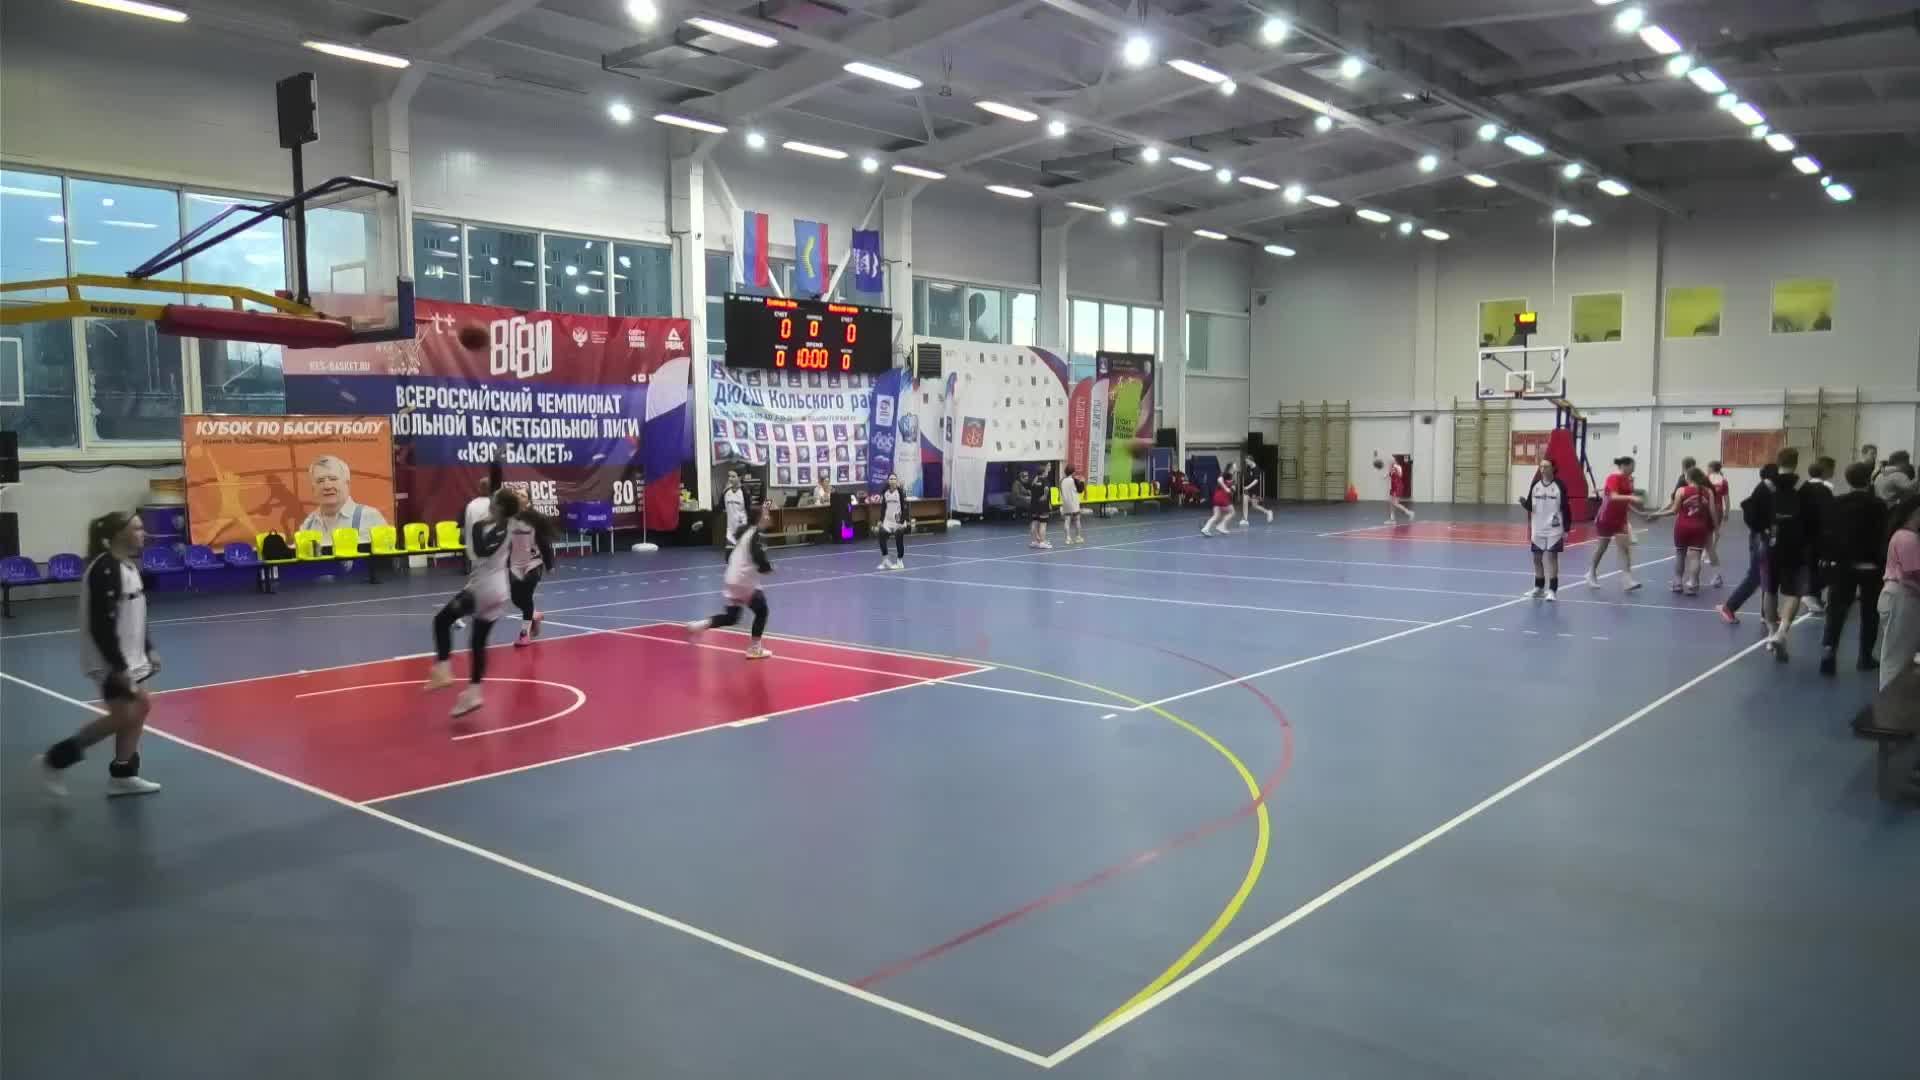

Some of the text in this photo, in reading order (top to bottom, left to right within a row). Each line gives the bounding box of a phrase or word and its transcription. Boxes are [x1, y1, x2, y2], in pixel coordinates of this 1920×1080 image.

[781, 318, 792, 339] 0
[810, 320, 819, 337] 0
[847, 323, 856, 343] 0
[776, 351, 785, 367] 0
[797, 348, 829, 368] 10:00
[842, 354, 851, 370] 0
[395, 384, 622, 414] ВСЕРОССИЙСКИЙ ЧЕМПИОНАТ
[768, 389, 844, 409] Кольского
[195, 421, 384, 435] КУБОК ПО БАСКЕТБОЛУ
[472, 414, 598, 439] БАСКЕТБОЛЬНОЙ
[602, 418, 640, 437] ЛИГИ
[530, 480, 558, 500] ВСЕ
[613, 479, 635, 505] 80
